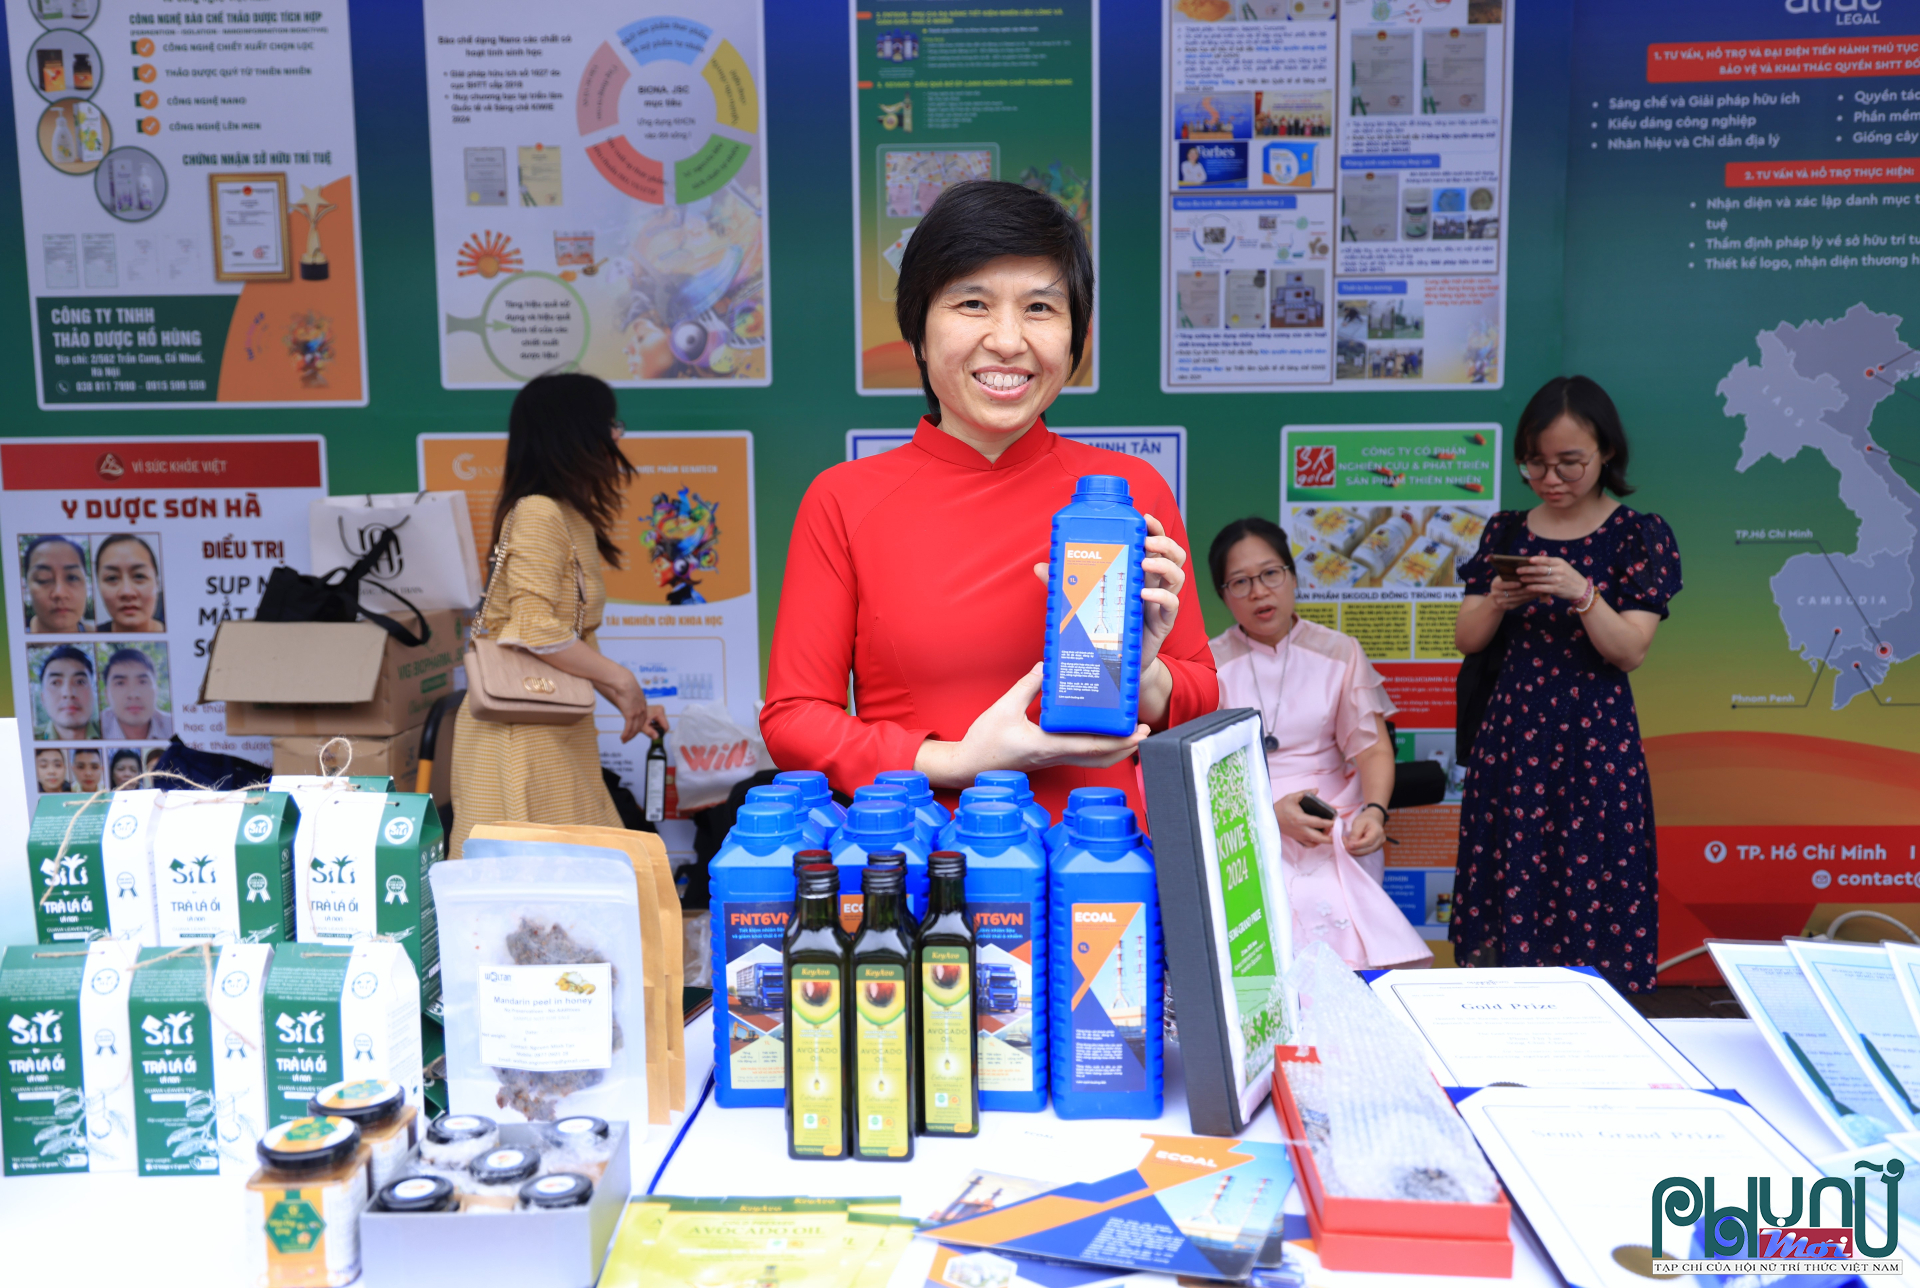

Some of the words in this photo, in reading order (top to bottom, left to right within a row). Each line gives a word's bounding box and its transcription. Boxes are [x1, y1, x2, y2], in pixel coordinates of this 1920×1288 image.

[1836, 12, 1881, 26] LEGAL
[1608, 97, 1641, 111] Sáng
[1670, 96, 1686, 108] và
[1717, 93, 1750, 109] pháp
[1780, 91, 1801, 105] ích
[1608, 115, 1637, 130] Kiểu
[1640, 115, 1673, 132] dáng
[1675, 114, 1709, 132] công
[1711, 114, 1756, 130] nghiệp
[1853, 130, 1893, 147] Giống
[1895, 130, 1919, 146] cây
[1706, 197, 1740, 212] Nhận
[1743, 196, 1772, 211] diện
[1775, 196, 1791, 208] và
[1794, 195, 1818, 208] xác
[1821, 194, 1842, 209] lập
[1845, 193, 1878, 206] danh
[1882, 194, 1911, 208] mục
[1705, 217, 1728, 232] tuệ
[1759, 254, 1793, 271] logo,
[1794, 255, 1828, 271] nhận
[1830, 254, 1859, 270] diện
[1861, 253, 1908, 270] thương
[51, 304, 91, 325] CÔNG
[94, 307, 112, 324] TY
[115, 307, 155, 324] TNHH
[52, 326, 90, 348] THẢO
[94, 330, 134, 350] DƯỢC
[160, 327, 202, 347] HÙNG
[1131, 438, 1161, 454] TÂN
[1361, 445, 1395, 457] CÔNG
[1397, 447, 1411, 456] TY
[131, 458, 144, 474] VÌ
[145, 458, 168, 474] SỨC
[170, 456, 200, 473] KHỎE
[201, 457, 227, 476] VIỆT
[1297, 446, 1331, 472] SK
[1297, 470, 1335, 486] gold
[61, 500, 78, 518] Y
[86, 497, 158, 525] DƯỢC
[164, 497, 217, 519] SƠN
[225, 492, 262, 518] HÀ
[1788, 528, 1813, 539] Minh
[251, 540, 285, 565] TRỊ
[1067, 549, 1102, 560] ECOAL
[1731, 694, 1763, 704] Phnom
[1764, 694, 1795, 704] Penh
[1217, 823, 1248, 862] KIWIE
[1737, 845, 1765, 860] TP.
[1771, 842, 1797, 860] Hồ
[1803, 843, 1835, 860] Chí
[1841, 843, 1887, 860] Minh
[1226, 855, 1249, 891] 2024
[67, 898, 80, 913] LÁ
[171, 899, 193, 912] TRÀ
[195, 899, 208, 912] LÁ
[210, 897, 221, 913] ỔI
[333, 899, 346, 912] LÁ
[348, 897, 359, 913] ỔI
[1075, 911, 1117, 923] ECOAL
[493, 996, 530, 1006] Mandarin
[533, 997, 552, 1007] peel
[554, 996, 563, 1005] in
[565, 997, 593, 1006] honey
[1461, 1002, 1503, 1010] Gold
[1510, 1002, 1558, 1010] Prize
[927, 1028, 968, 1036] AVOCADO
[797, 1047, 838, 1055] AVOCADO
[861, 1048, 903, 1056] AVOCADO
[36, 1056, 50, 1072] LÁ
[168, 1057, 183, 1073] LÁ
[301, 1056, 314, 1071] LÁ
[874, 1056, 888, 1064] OIL
[1155, 1150, 1218, 1168] ECOAL
[687, 1226, 788, 1236] AVOCADO
[792, 1226, 823, 1235] OIL
